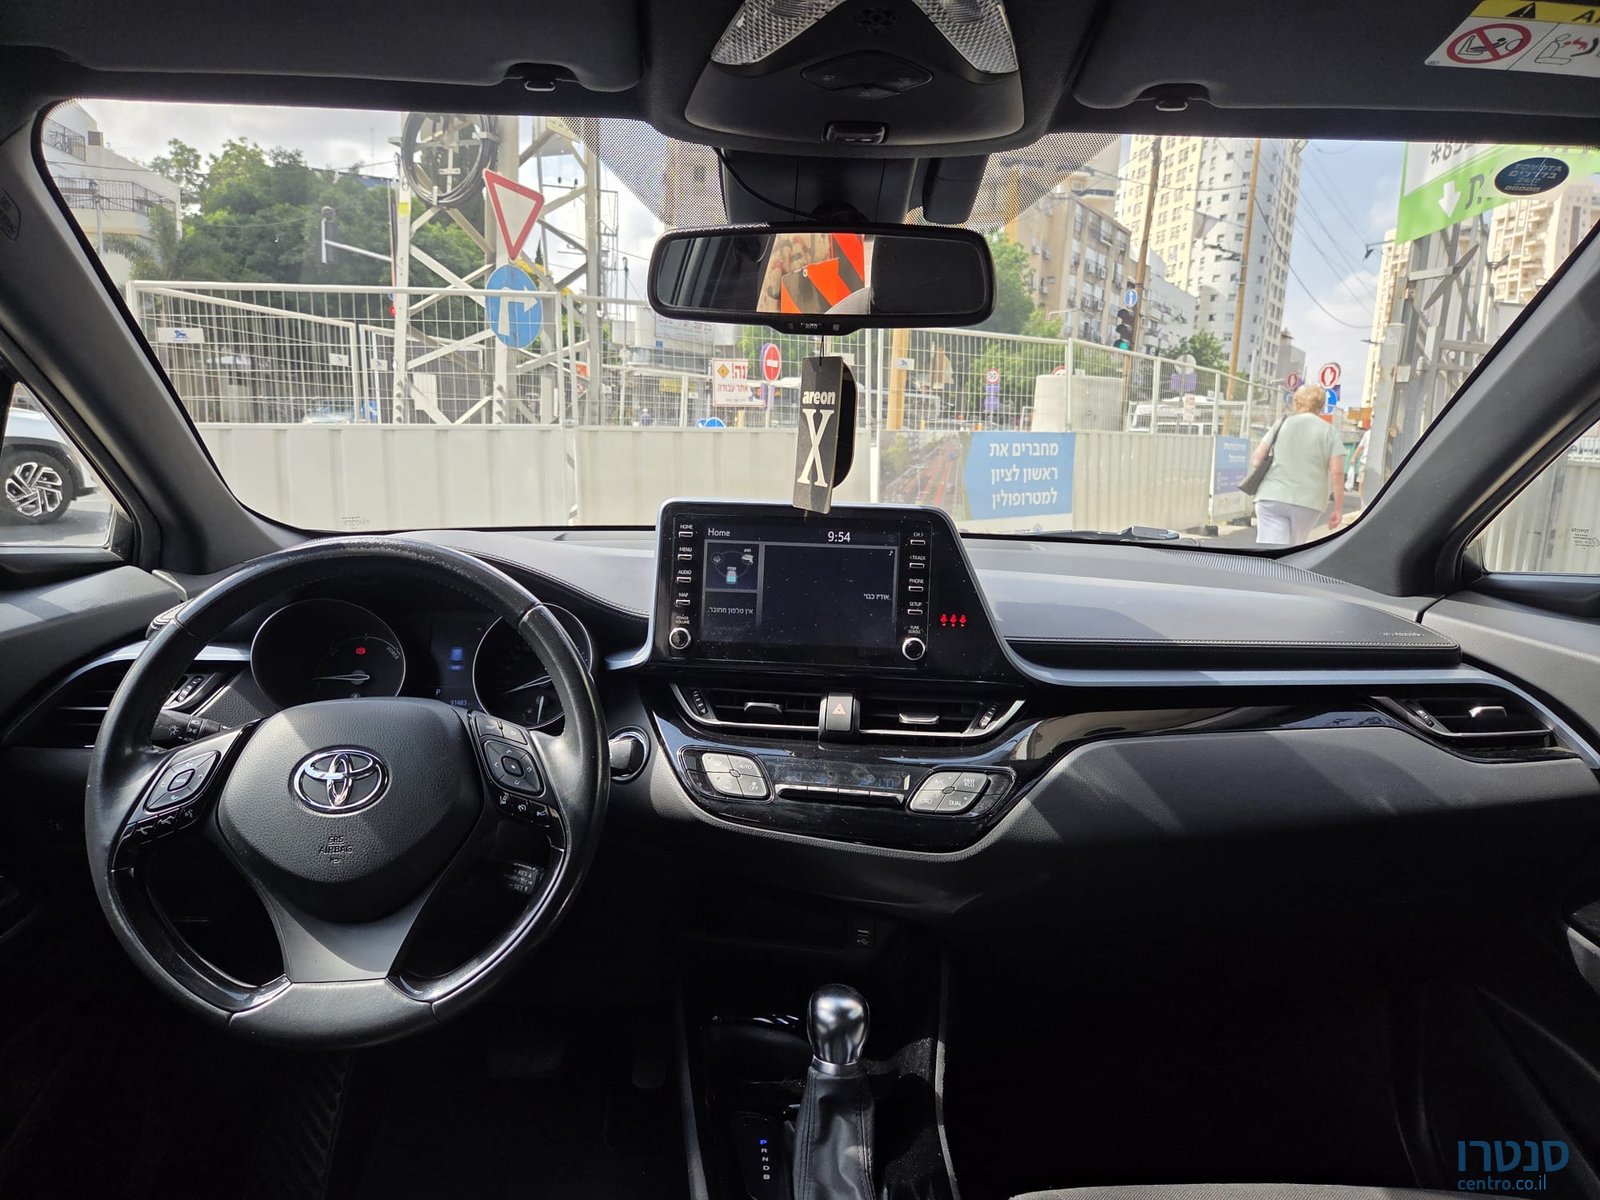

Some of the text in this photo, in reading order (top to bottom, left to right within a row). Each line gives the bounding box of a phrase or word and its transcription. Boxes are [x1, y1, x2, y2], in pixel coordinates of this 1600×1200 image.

[1514, 163, 1562, 172] TOYOTA
[802, 390, 836, 405] areon
[797, 408, 835, 487] X
[988, 442, 1059, 457] מחברים את
[990, 463, 1058, 485] ראשון לציון
[992, 487, 1058, 510] למטרופולין
[707, 528, 731, 537] Home
[827, 531, 851, 542] 9:54
[728, 607, 744, 615] טלפון
[319, 845, 353, 855] AIRBAG
